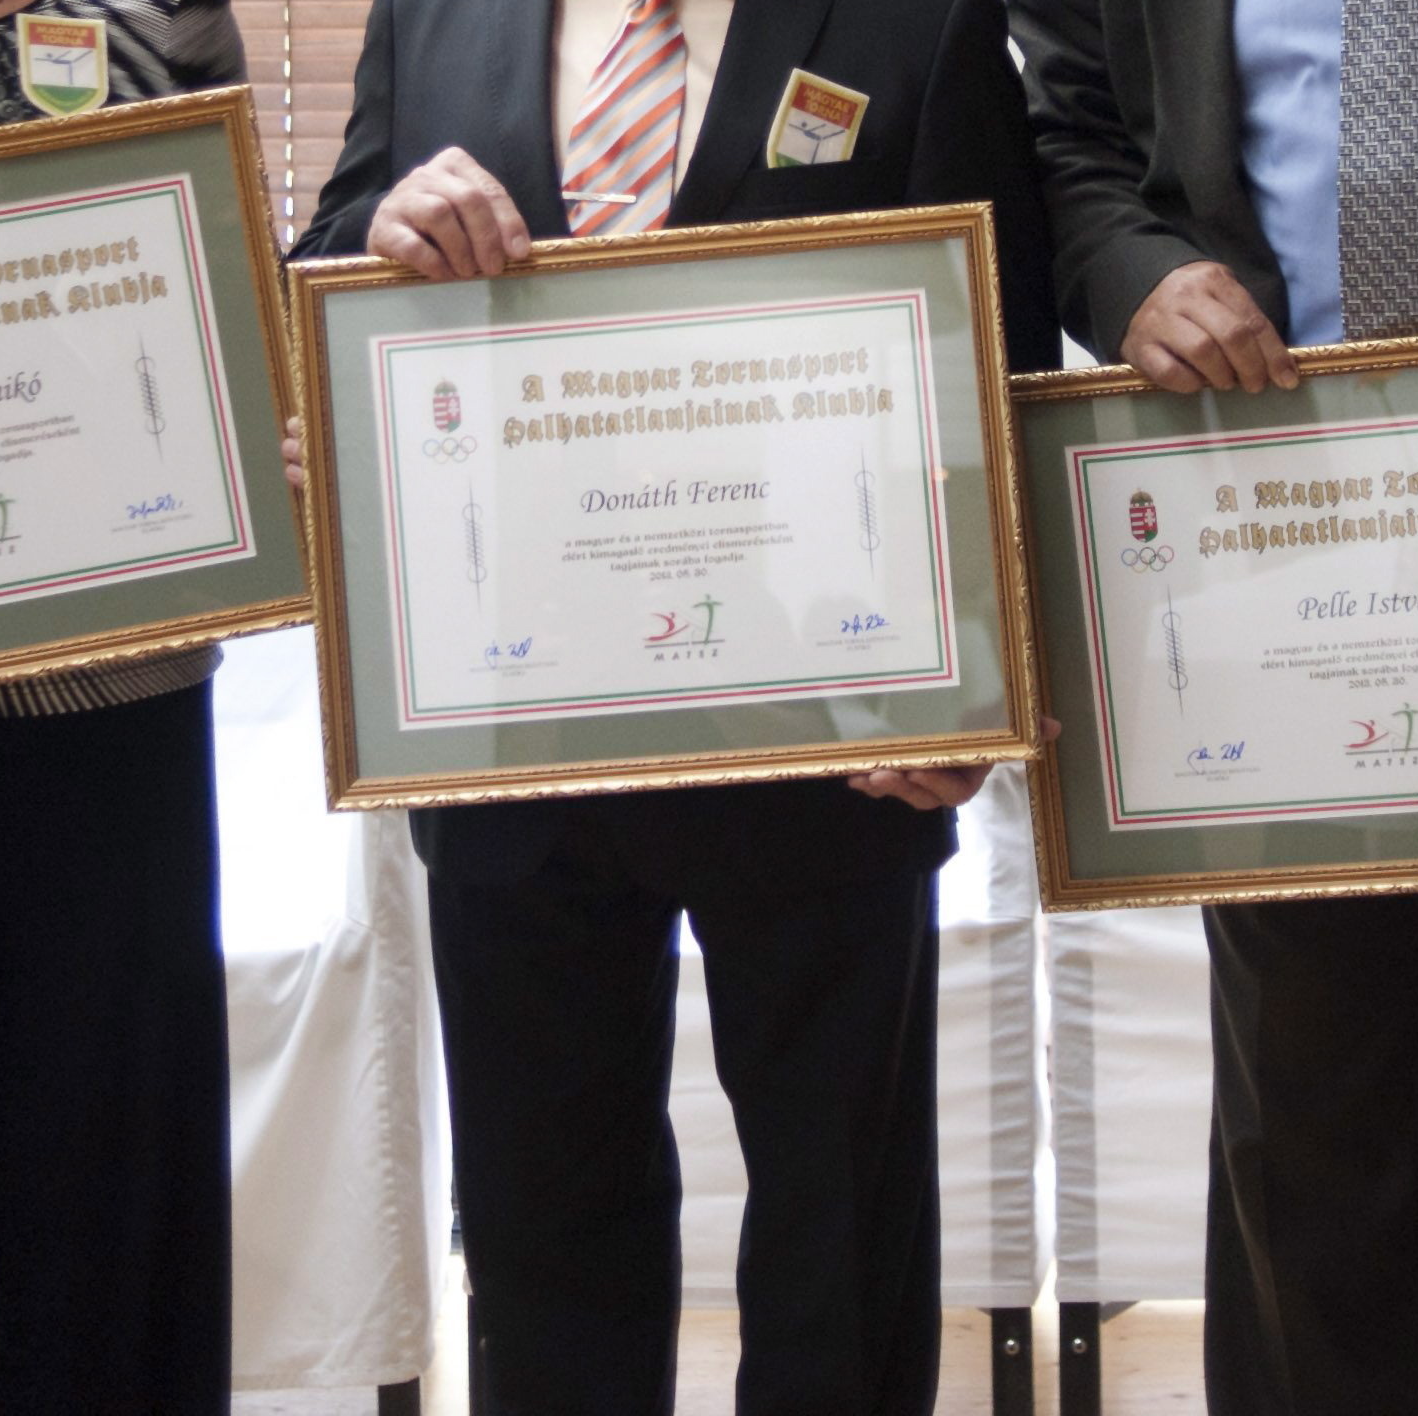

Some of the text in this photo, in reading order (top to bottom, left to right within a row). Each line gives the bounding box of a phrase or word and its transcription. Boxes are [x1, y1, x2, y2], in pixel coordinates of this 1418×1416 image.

[804, 88, 850, 113] MAGYAR
[805, 100, 842, 121] TORNA
[67, 272, 168, 314] Klubja
[521, 346, 869, 403] A Magyar Tornasport
[792, 384, 894, 420] Klubja
[580, 479, 770, 513] Donáth Ferenc
[1216, 484, 1239, 513] A
[1255, 477, 1372, 509] Magyar
[1298, 590, 1357, 620] Pelle
